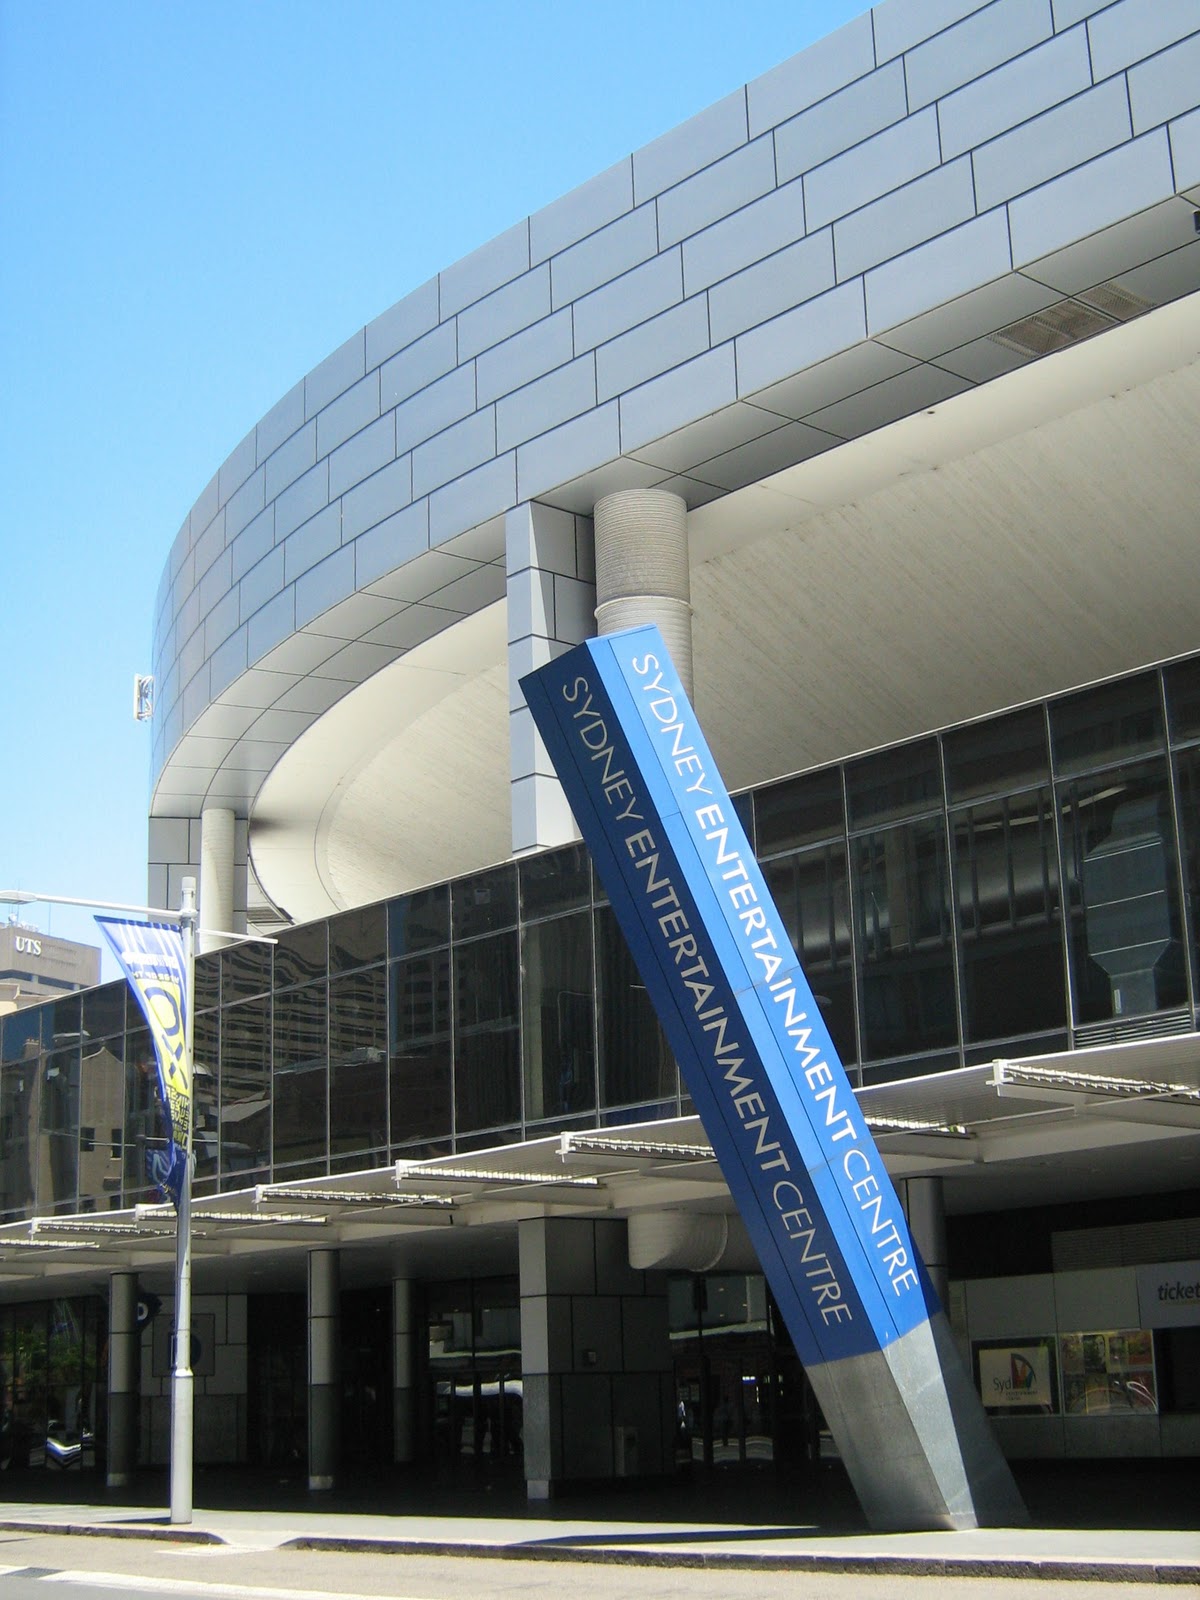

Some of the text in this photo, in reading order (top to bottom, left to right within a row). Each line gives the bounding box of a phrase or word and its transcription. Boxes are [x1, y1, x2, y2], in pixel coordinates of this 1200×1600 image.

[15, 936, 42, 957] UTS
[562, 677, 853, 1326] SYDNEY ENTERTAINMENT CENTRE
[632, 654, 918, 1297] SYDNEY ENTERTAINMENT CENTRE
